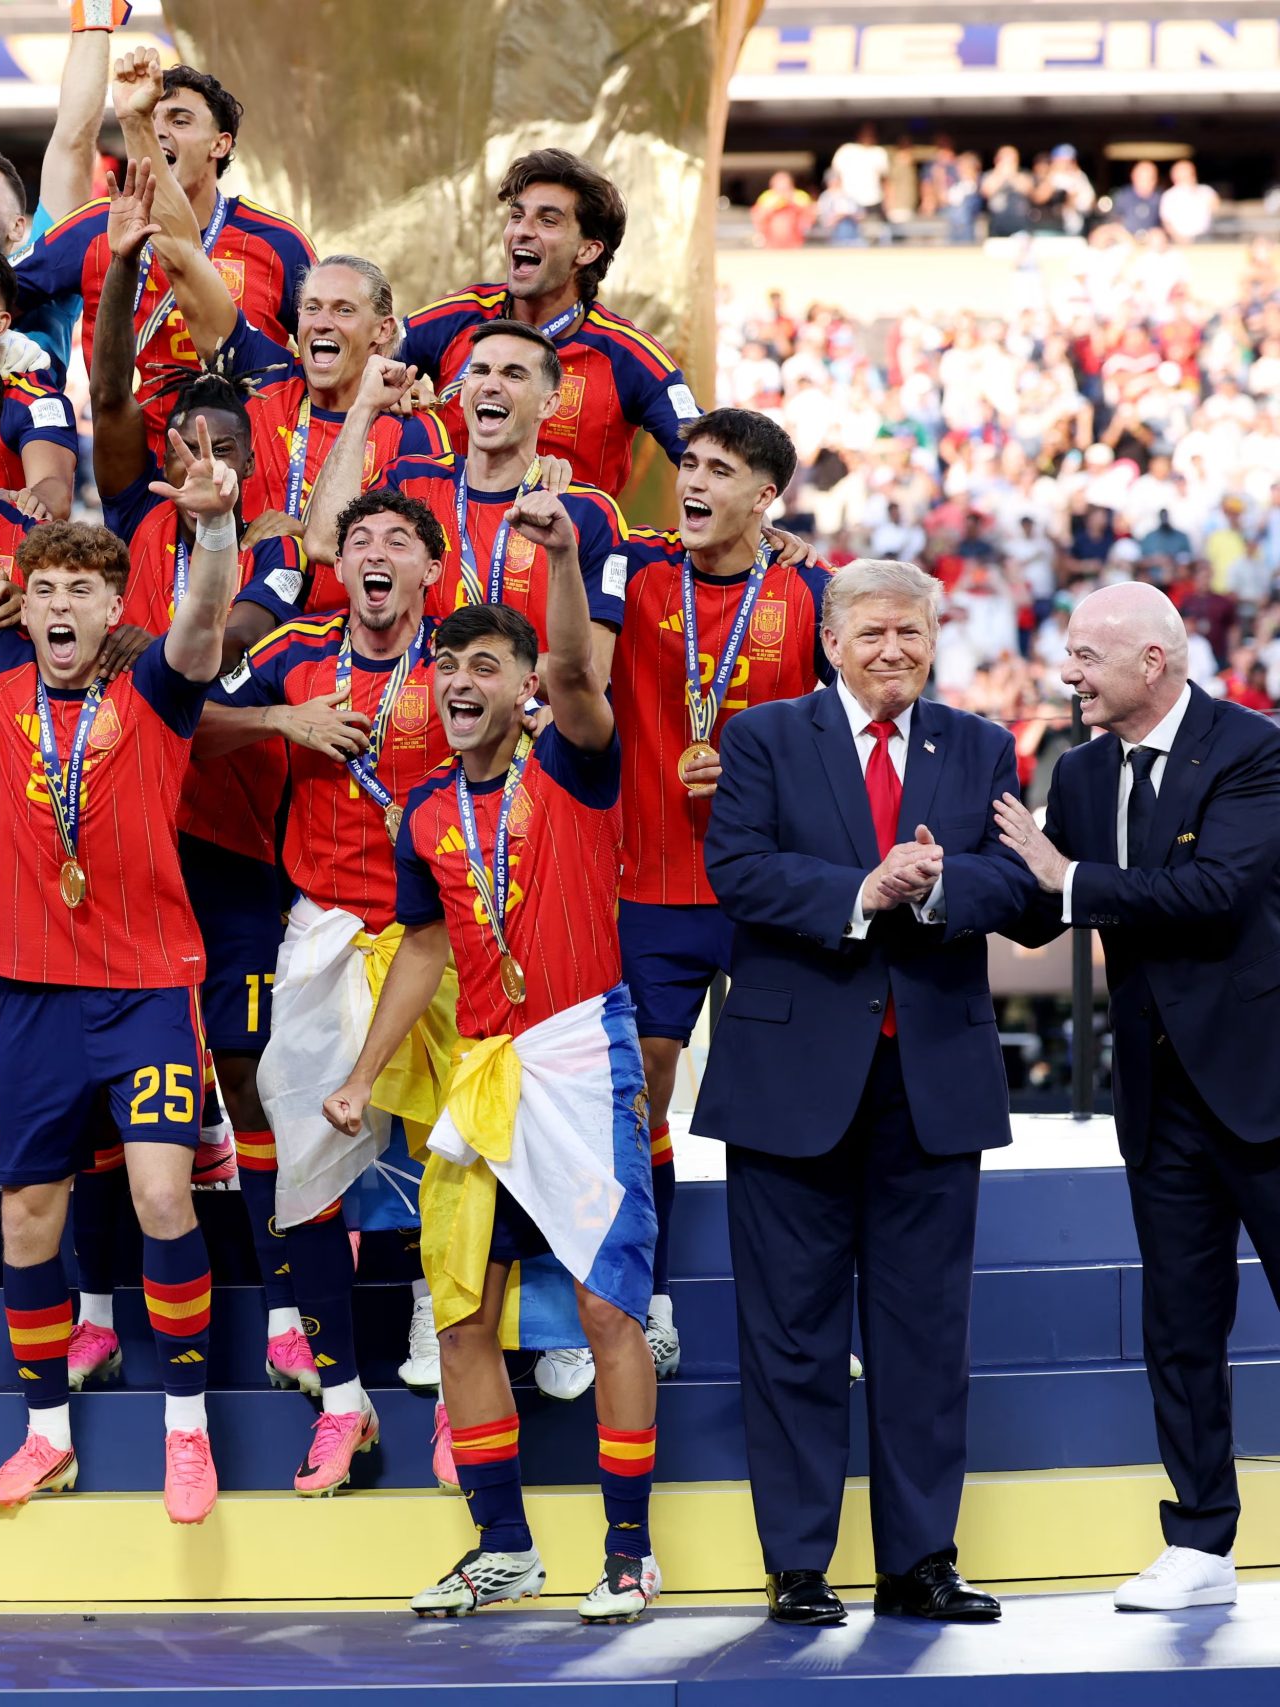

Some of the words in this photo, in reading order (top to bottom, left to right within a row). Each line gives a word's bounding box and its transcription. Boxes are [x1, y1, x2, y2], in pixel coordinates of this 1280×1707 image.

[732, 23, 964, 74] HE
[209, 209, 223, 235] WORLD
[550, 314, 570, 332] 2026
[290, 472, 300, 490] FIFA
[288, 491, 297, 515] WORL
[494, 529, 506, 560] 2026
[177, 558, 186, 588] WORLD
[492, 560, 501, 579] CUP
[490, 578, 500, 604] ORLD
[686, 622, 694, 639] CUP
[717, 663, 728, 684] FIFA
[723, 634, 738, 665] WORLD
[733, 618, 745, 636] CUP
[740, 586, 756, 617] 2026
[687, 639, 696, 671] 2026
[38, 703, 47, 721] CUP
[41, 721, 53, 753] 2026
[75, 720, 88, 752] 2026
[71, 755, 80, 771] CUP
[69, 772, 79, 806] WORLD
[351, 758, 362, 775] FIFA
[362, 772, 387, 799] WORLD
[461, 800, 470, 817] CUP
[498, 810, 508, 831] FIFA
[464, 818, 476, 850] 2026
[1177, 832, 1196, 845] FIFA
[497, 832, 505, 865] WORLD
[497, 865, 505, 885] CUP
[497, 885, 505, 919] 2026
[130, 1063, 194, 1125] 25
